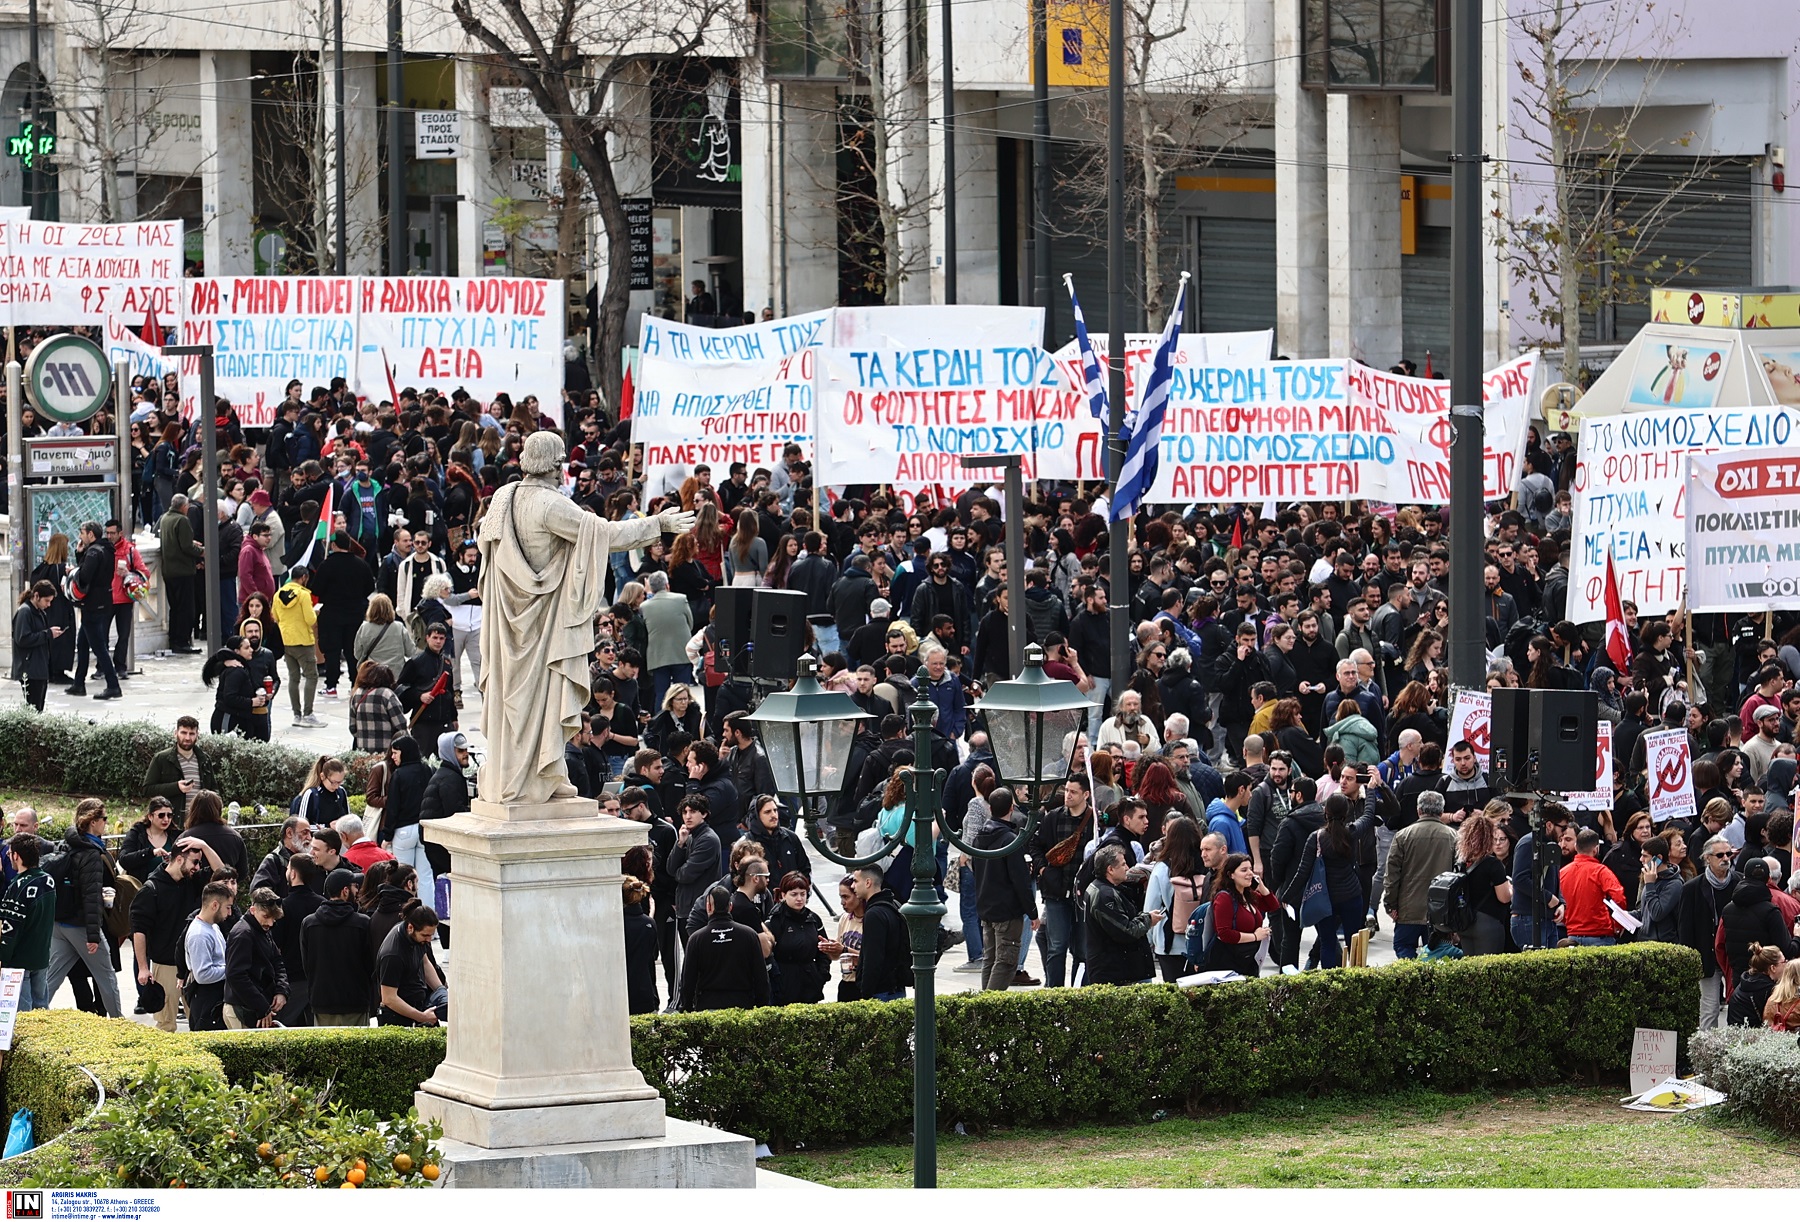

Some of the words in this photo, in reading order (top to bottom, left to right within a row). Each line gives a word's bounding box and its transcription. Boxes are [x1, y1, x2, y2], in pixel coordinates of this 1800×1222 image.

[421, 113, 458, 123] ΕΞΟΔΟΣ
[427, 124, 452, 133] ΠΡΟΣ
[420, 135, 460, 144] ΣΤΑΔΙΟΥ
[628, 215, 650, 223] ELETS
[630, 227, 649, 235] LADS
[43, 226, 65, 245] ΟΙ
[78, 225, 126, 247] ΖΩΕΣ
[137, 224, 175, 247] ΜΑΣ
[33, 256, 52, 278] ΜΕ
[57, 257, 91, 278] ΑΞΙΑ
[95, 258, 140, 278] ΔΟΥΛΕΙΑ
[152, 259, 172, 279] ΜΕ
[191, 279, 220, 315] ΝΑ
[232, 279, 289, 314] ΜΗΝ
[296, 279, 353, 314] ΓΙΝΕΙ
[362, 280, 375, 313] Η
[379, 279, 451, 313] ΑΔΙΚΙΑ
[466, 279, 547, 316] ΝΟΜΟΣ
[216, 319, 256, 352] ΣΤΑ
[264, 318, 353, 351] ΙΔΙΩΤΙΚΑ
[401, 317, 496, 348] ΠΤΥΧΙΑ
[510, 319, 539, 349] ΜΕ
[668, 330, 694, 360] ΤΑ
[699, 332, 765, 361] ΚΕΡΔΗ
[772, 318, 826, 355] ΤΟΥΣ
[215, 353, 348, 378] ΠΑΝΕΠΙΣΤΗΜΙΑ
[419, 347, 482, 378] ΑΞΙΑ
[850, 351, 888, 388] ΤΑ
[895, 348, 984, 388] ΚΕΡΔΗ
[992, 347, 1059, 386] ΤΟΥΣ
[1189, 367, 1266, 404] ΚΕΡΔΗ
[1273, 366, 1343, 401] ΤΟΥΣ
[1373, 374, 1451, 414] ΣΠΟΥΔΕ
[638, 390, 660, 417] ΝΑ
[672, 385, 772, 418] ΑΠΟΣΥΡΘΕΙ
[785, 384, 812, 411] ΤΟ
[843, 390, 863, 425] ΟΙ
[870, 390, 987, 426] ΦΟΙΤΗΤΕΣ
[701, 412, 807, 436] ΦΟΙΤΗΤΙΚΟΙ
[1181, 406, 1314, 434] ΠΛΕΙΟΨΗΦΙΑ
[1590, 422, 1613, 454] ΤΟ
[1621, 411, 1791, 450] ΝΟΜΟΣΧΕΔΙΟ
[892, 425, 920, 452] ΤΟ
[1161, 435, 1195, 463] ΤΟ
[1205, 433, 1396, 465] ΝΟΜΟΣΧΕΔΙΟ
[33, 449, 111, 460] Πανεπιήμιο
[648, 443, 763, 466] ΠΑΛΕΥΟΥΜΕ
[1172, 462, 1359, 498] ΑΠΟΡΡΙΠΤΕΤΑΙ
[1575, 462, 1590, 493] ΟΙ
[1720, 466, 1758, 492] ΟΧΙ
[1589, 490, 1650, 526] ΠΤΥΧΙΑ
[1584, 532, 1605, 566] ΜΕ
[1705, 544, 1771, 566] ΠΤΥΧΙΑ
[1636, 1031, 1665, 1043] ΤΕΡΜΑ
[1643, 1043, 1660, 1053] ΠΙΑ
